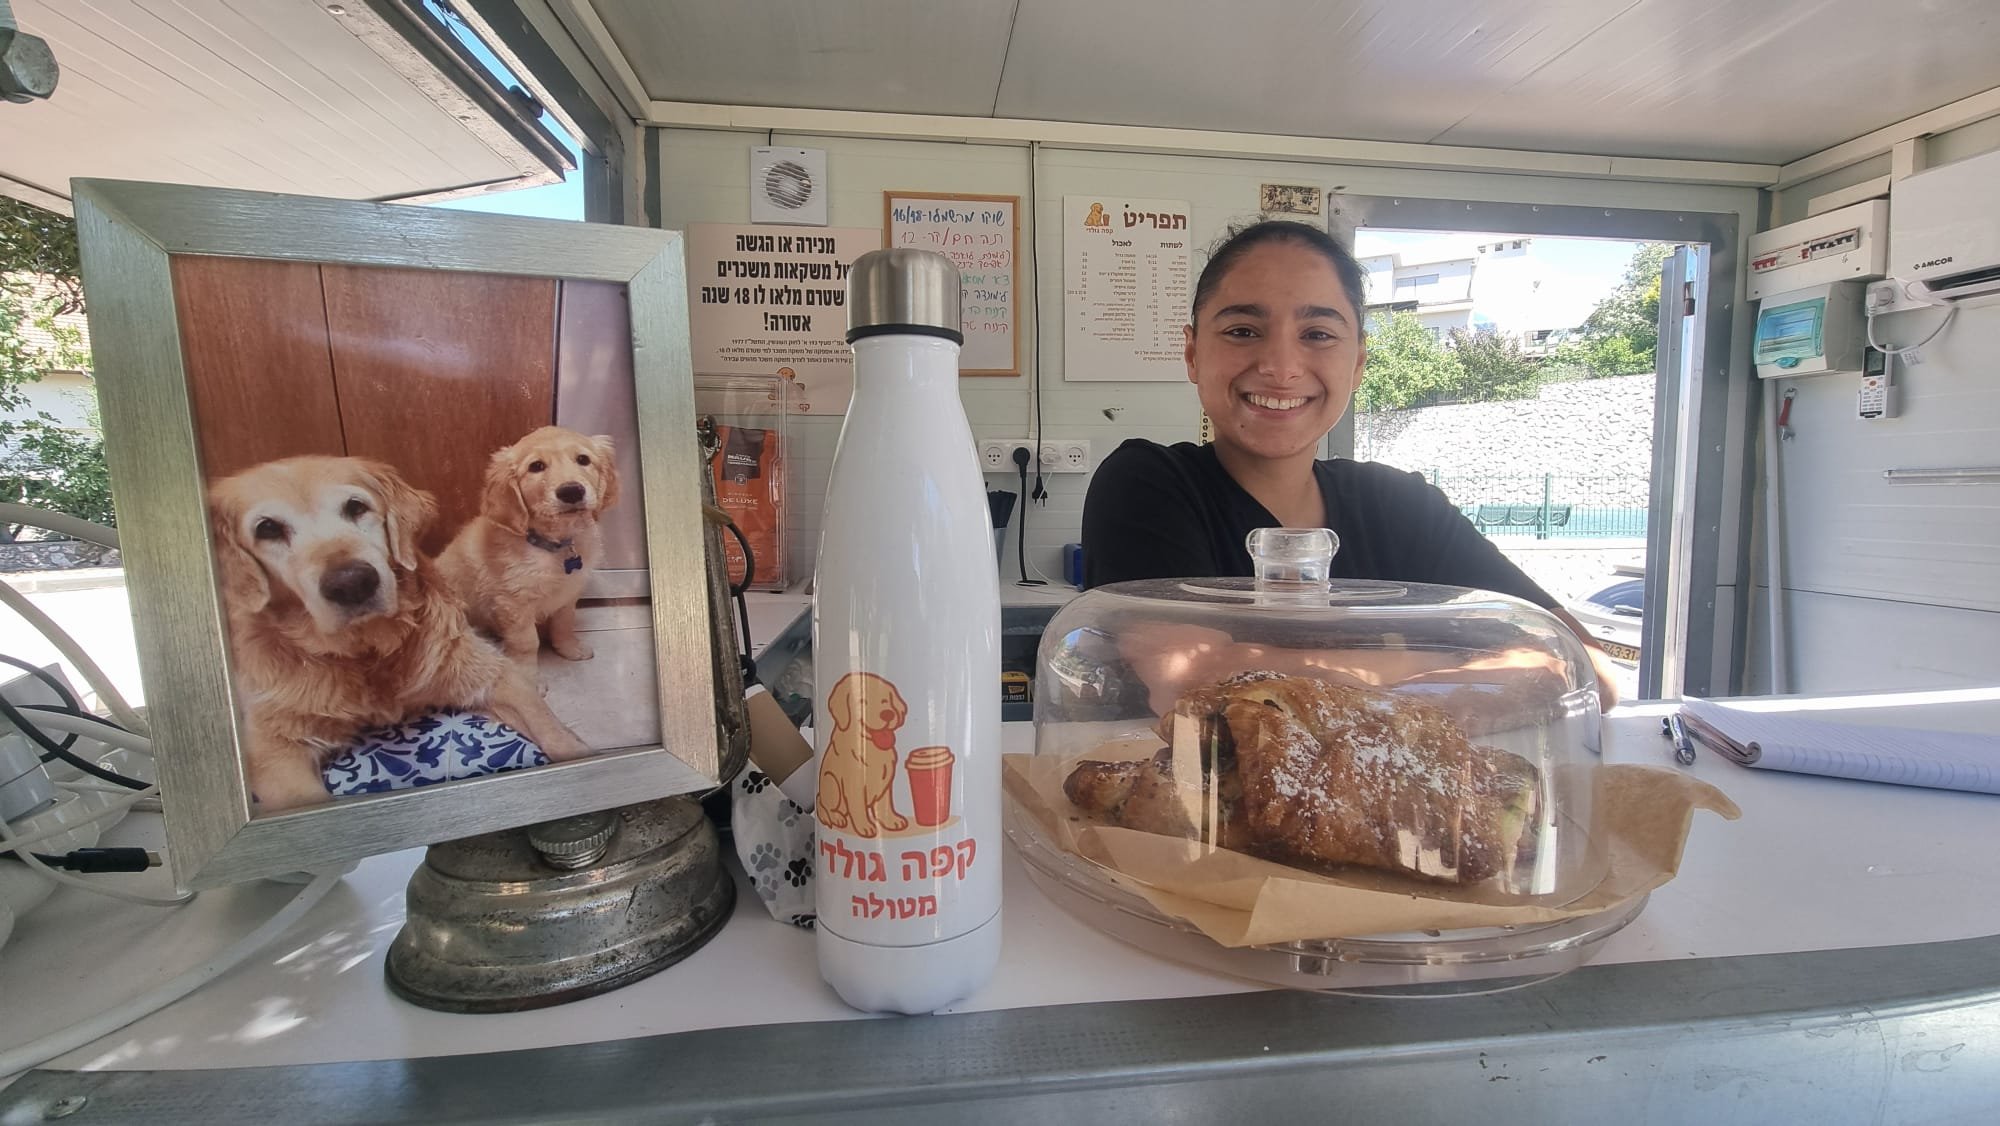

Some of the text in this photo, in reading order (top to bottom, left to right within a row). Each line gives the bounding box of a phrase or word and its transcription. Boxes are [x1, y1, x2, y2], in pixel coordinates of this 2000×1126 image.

[981, 210, 1005, 226] שוקו
[1123, 212, 1187, 230] תפריט
[736, 234, 836, 254] מכירה או הגשה
[1112, 240, 1132, 248] לאכול
[717, 261, 771, 279] משכרים
[774, 262, 831, 283] משקאות
[1921, 257, 1953, 268] AMCOR
[701, 284, 845, 306] שטרם מלאו לו 18 שנה
[763, 312, 812, 332] אסורה!
[819, 838, 977, 882] קפה גולדי
[851, 892, 938, 920] מטולה
